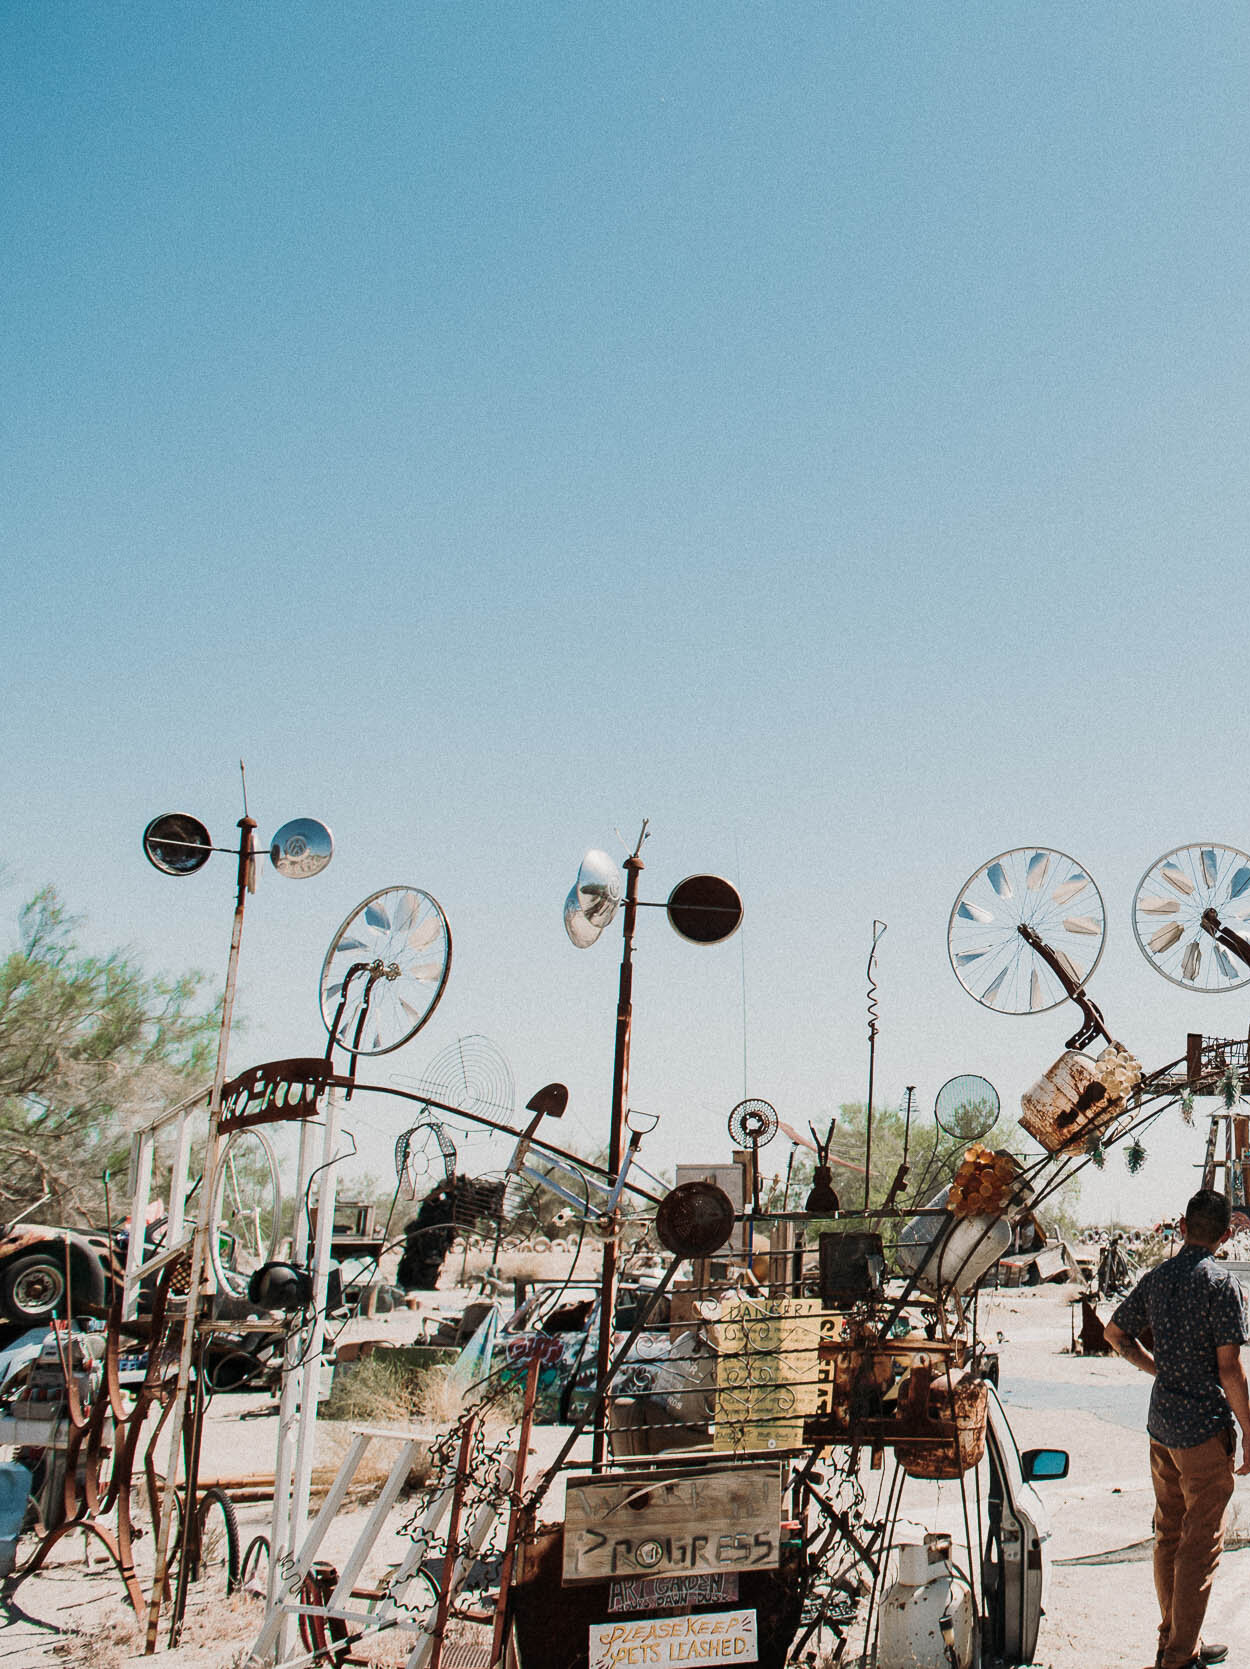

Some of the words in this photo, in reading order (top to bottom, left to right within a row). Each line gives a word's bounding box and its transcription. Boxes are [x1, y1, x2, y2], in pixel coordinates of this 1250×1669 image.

[600, 1622, 685, 1657] PLEASE
[685, 1617, 740, 1637] KEEP
[611, 1641, 662, 1669] PETS
